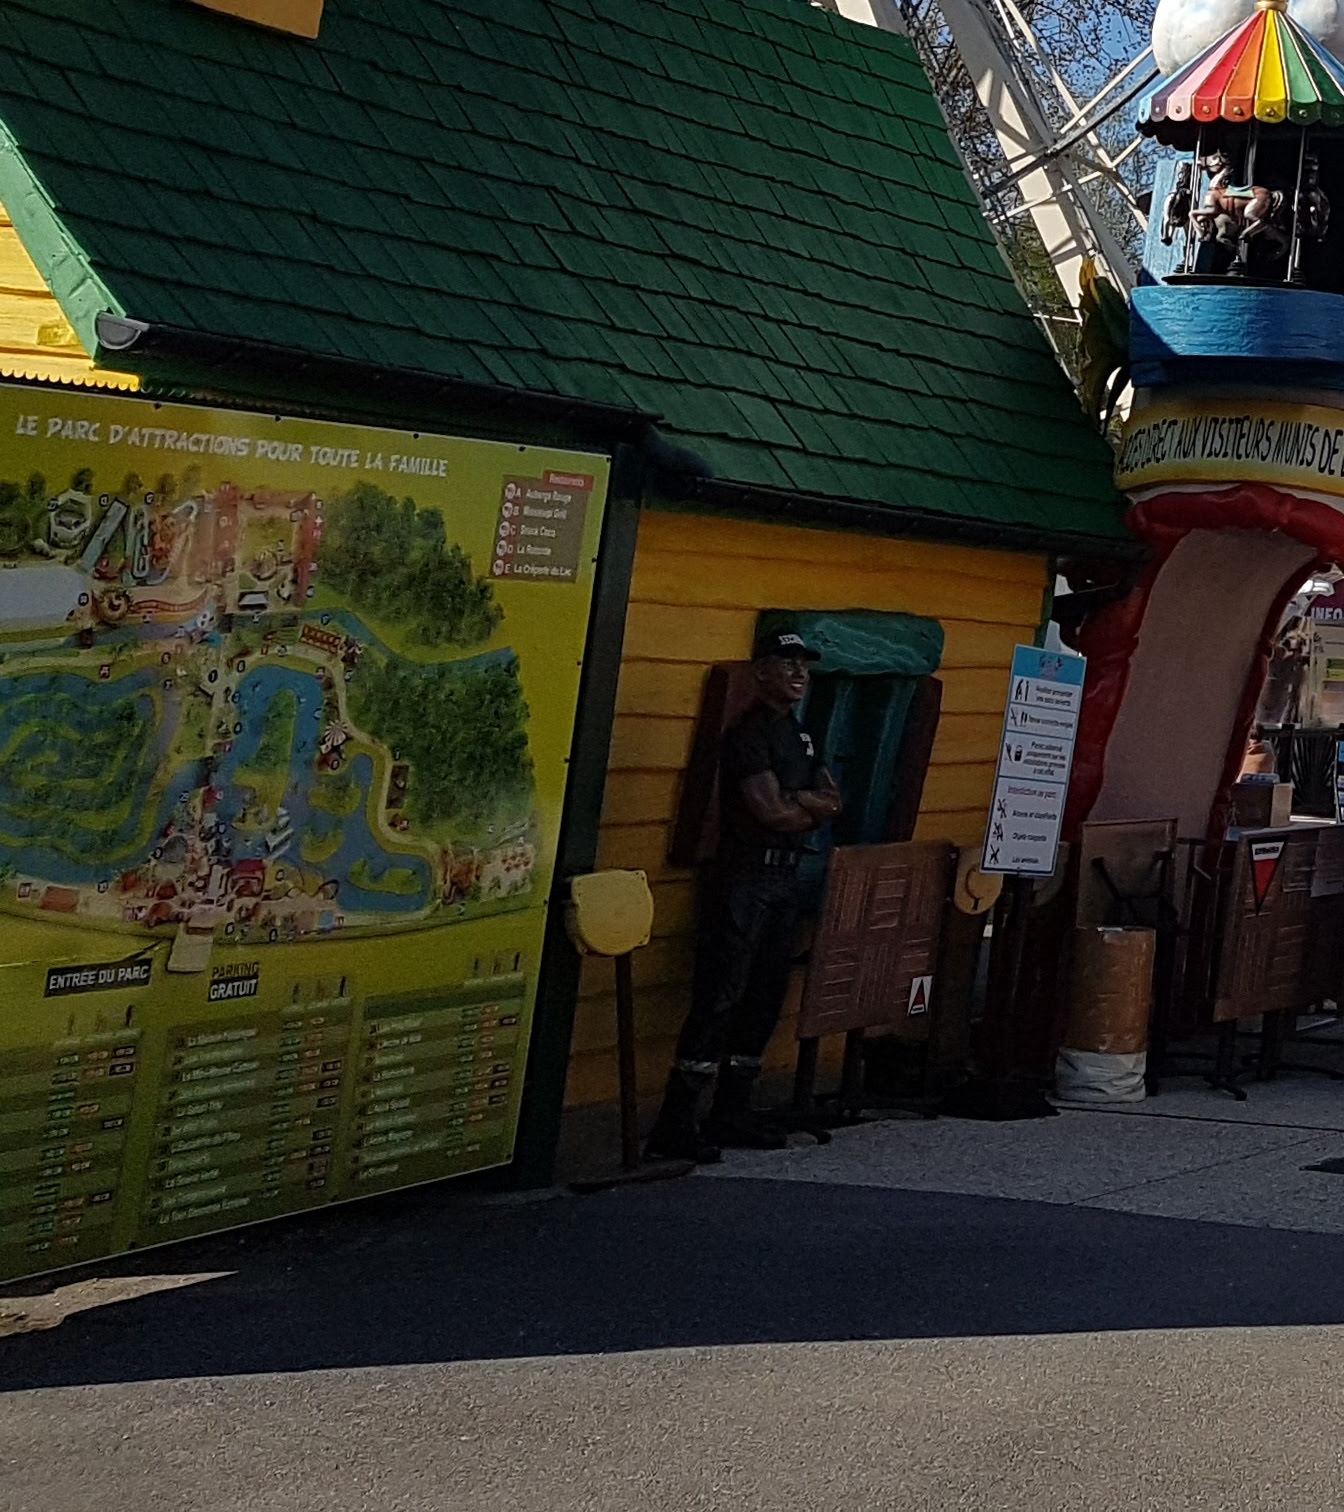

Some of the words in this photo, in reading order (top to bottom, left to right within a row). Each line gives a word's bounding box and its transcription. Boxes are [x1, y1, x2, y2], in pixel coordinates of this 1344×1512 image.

[15, 414, 38, 436] LE
[45, 417, 99, 442] PARC
[108, 424, 250, 457] D'ATTRACTIONS
[255, 438, 303, 462] POUR
[310, 445, 360, 469] TOUTE
[365, 452, 383, 470] LA
[389, 454, 449, 477] FAMILLE
[1174, 415, 1202, 459] AUX
[1200, 414, 1275, 462] VISITEURS
[1272, 420, 1320, 468] MUNIS
[1318, 427, 1344, 476] DE
[48, 969, 97, 990] ENTRÉE
[98, 968, 115, 985] DU
[117, 965, 150, 983] PARC
[212, 962, 260, 978] PARKING
[209, 978, 258, 999] GRATUIT
